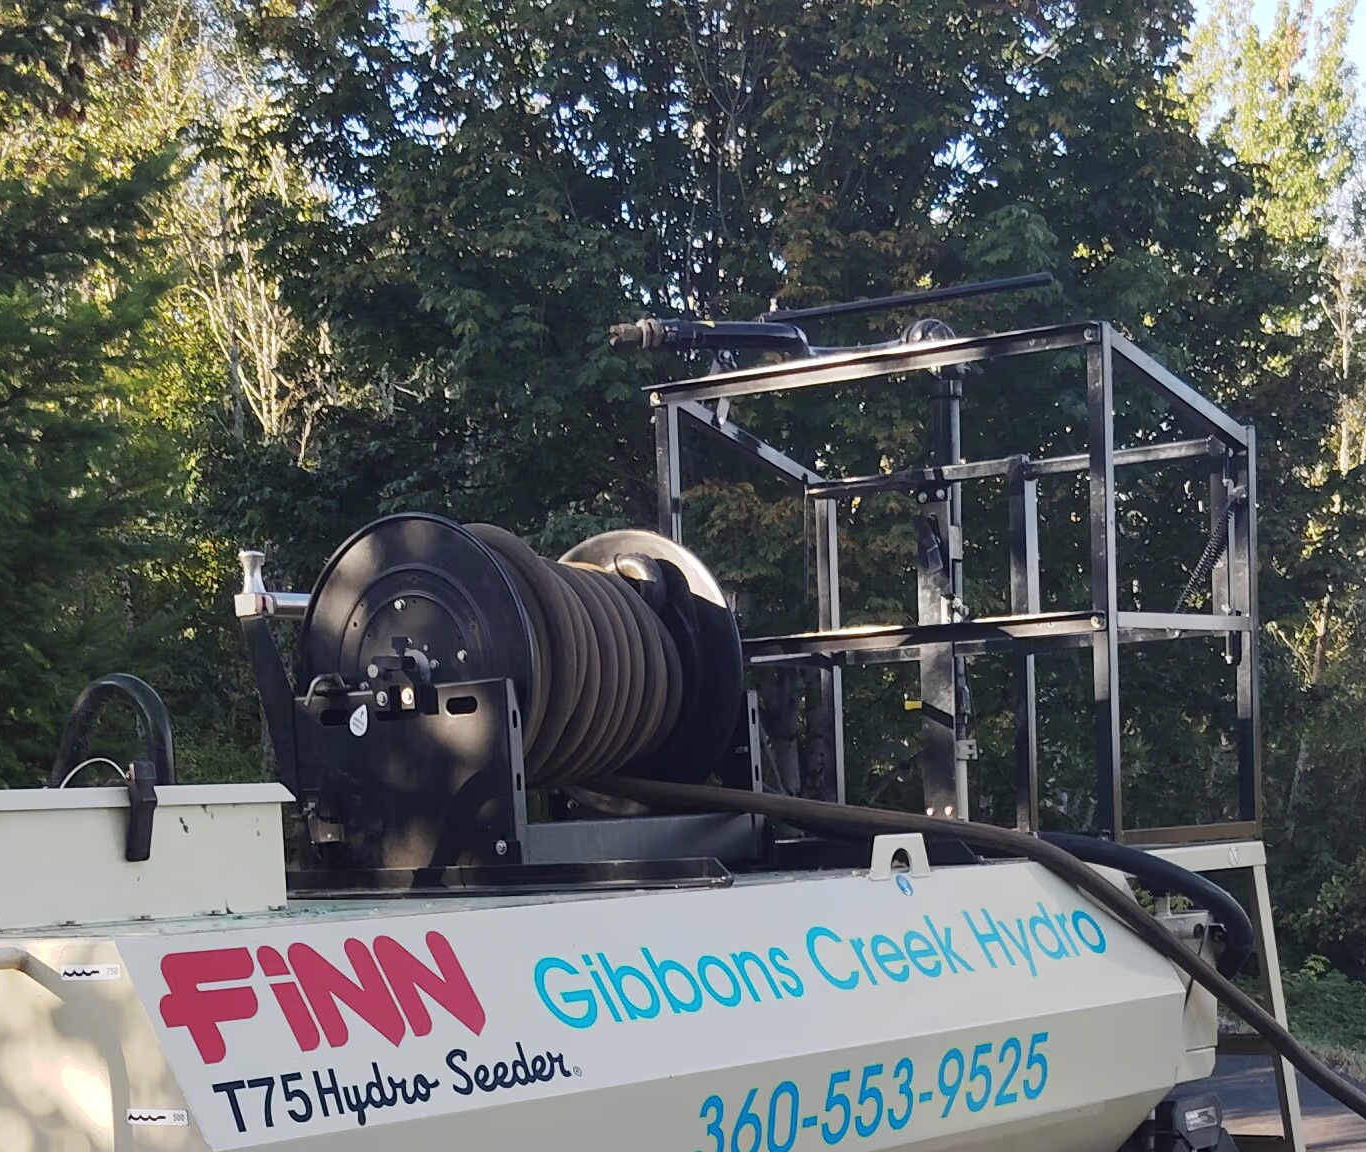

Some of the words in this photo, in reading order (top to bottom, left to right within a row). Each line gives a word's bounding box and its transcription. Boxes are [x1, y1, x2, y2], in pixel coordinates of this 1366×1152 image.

[534, 947, 804, 1029] Gibbons
[806, 916, 973, 989] Creek
[964, 903, 1107, 976] Hydro
[212, 1072, 313, 1132] T75
[314, 1062, 439, 1126] Hydro
